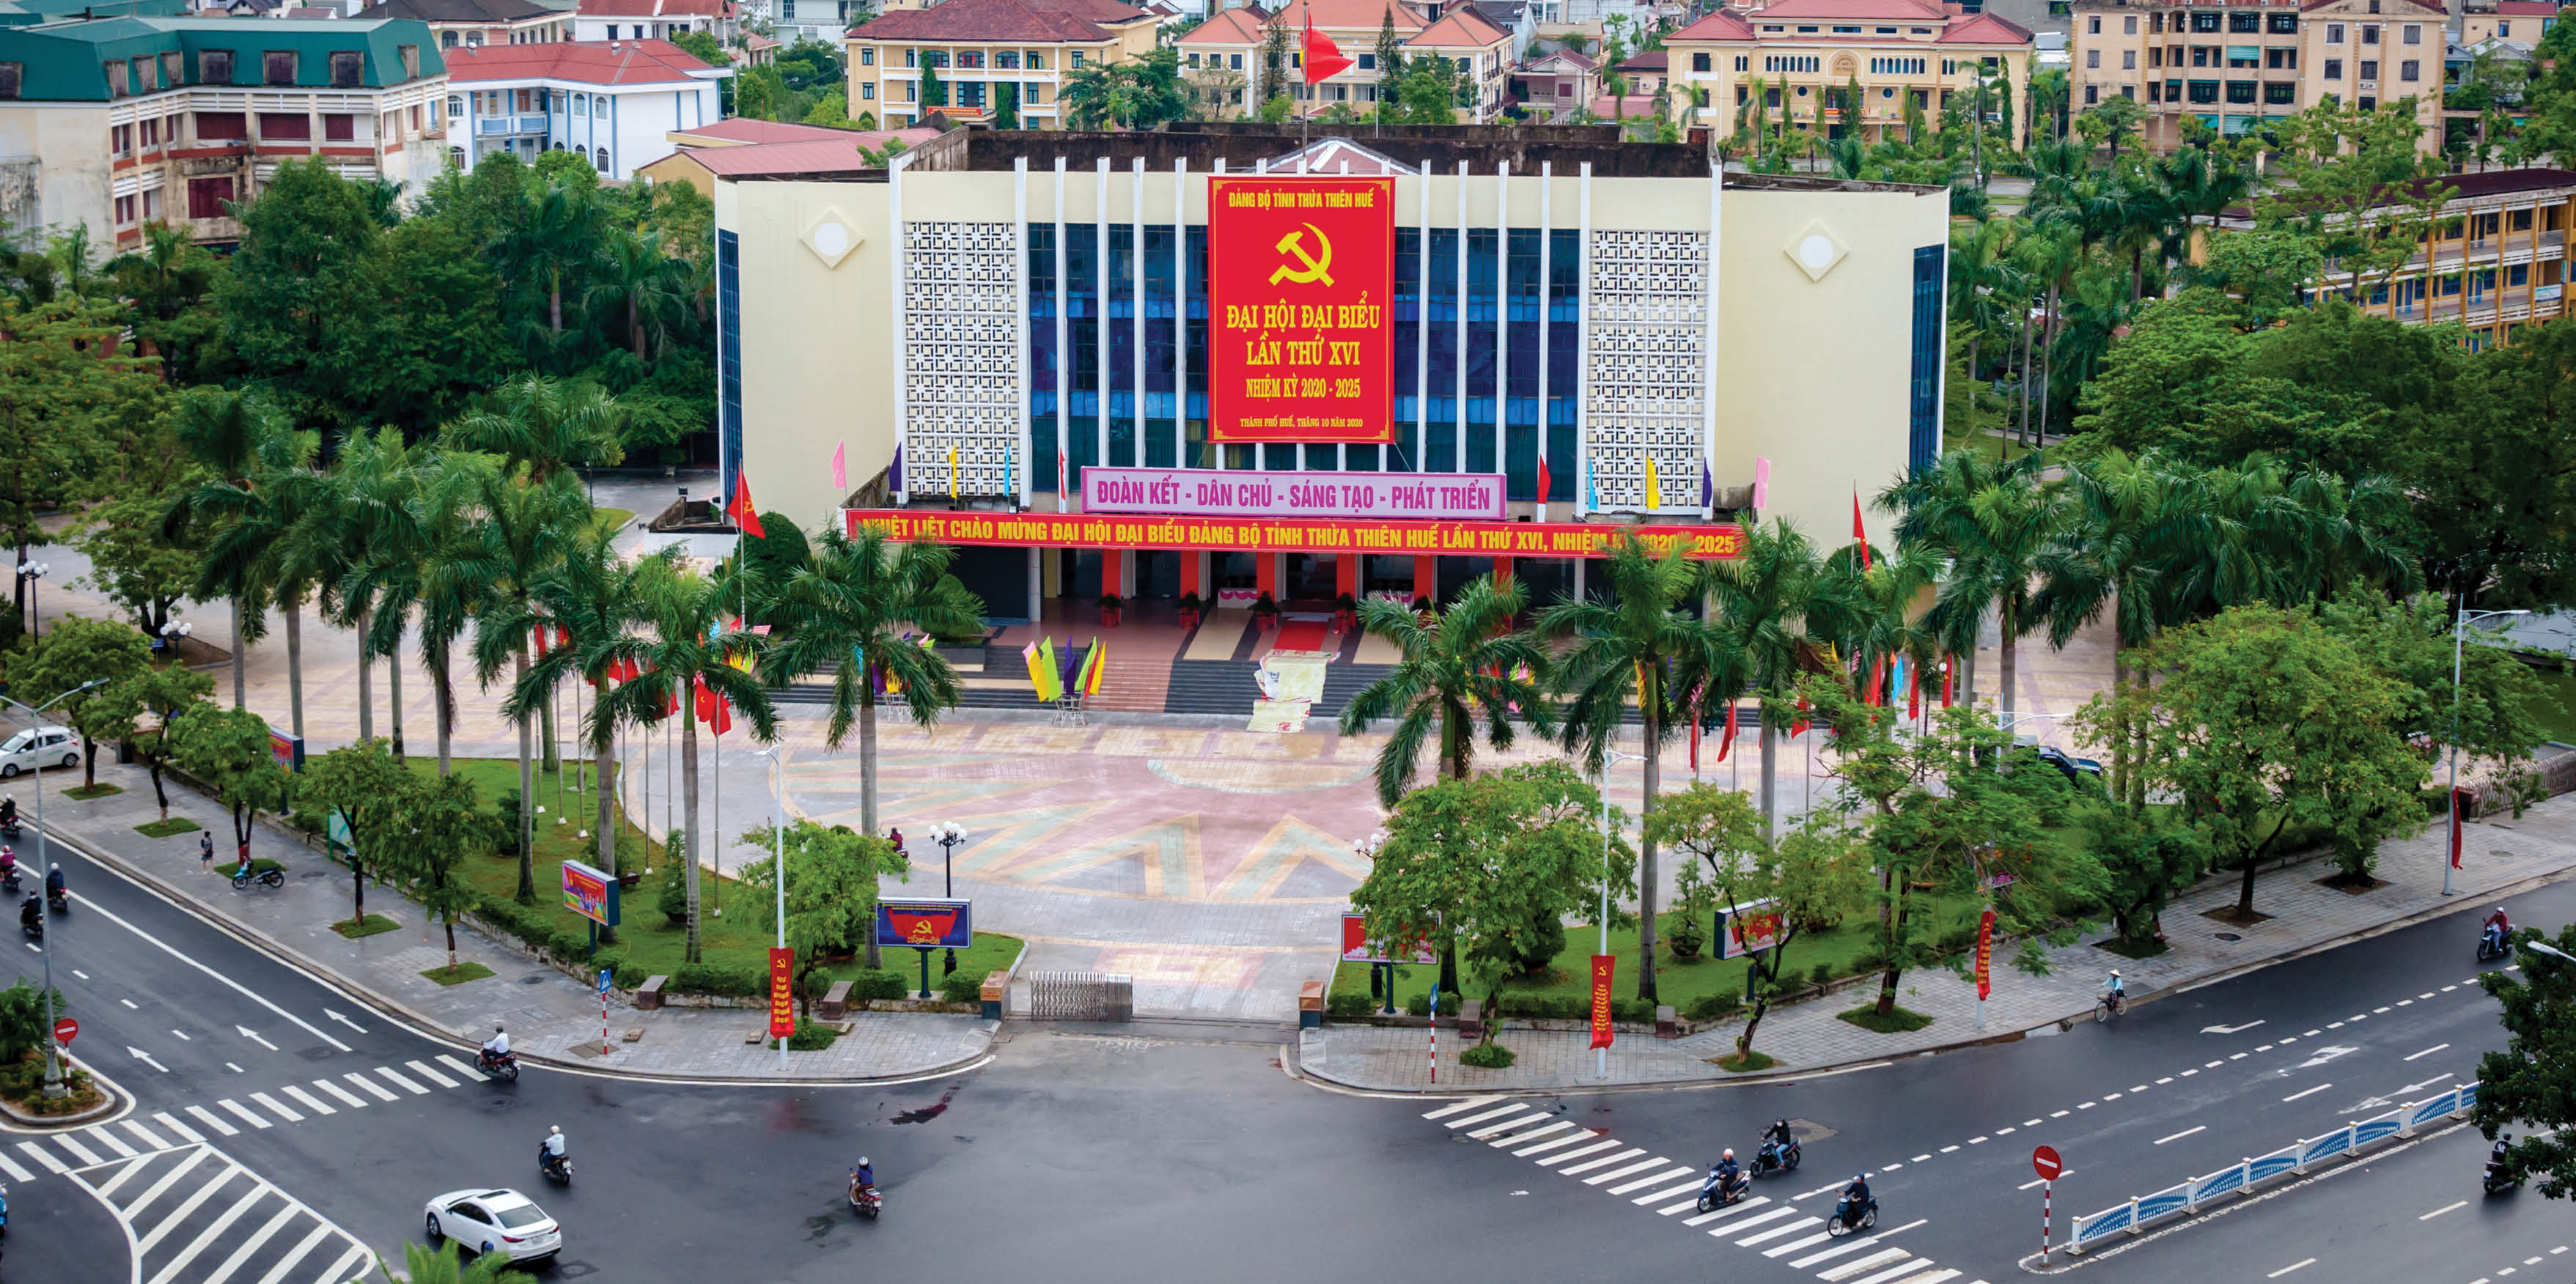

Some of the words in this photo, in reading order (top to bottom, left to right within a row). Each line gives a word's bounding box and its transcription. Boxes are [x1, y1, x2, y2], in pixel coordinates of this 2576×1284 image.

[1229, 188, 1256, 207] ĐẢNG
[1257, 189, 1271, 211] BỘ
[1273, 188, 1295, 207] TỈNH
[1298, 188, 1323, 207] THỪA
[1325, 189, 1353, 207] THIÊN
[1355, 187, 1375, 207] HUẾ
[1226, 305, 1259, 333] ĐẠI
[1263, 298, 1296, 333] HỘI
[1300, 305, 1333, 333] ĐẠI
[1338, 290, 1380, 328] BIỂU
[1246, 330, 1281, 365] LẦN
[1287, 333, 1325, 365] THỨ
[1328, 341, 1361, 365] XVI
[1245, 373, 1281, 402] NHIỆM
[1283, 372, 1298, 398] KỲ
[1301, 377, 1327, 398] 2020
[1336, 377, 1361, 398] 2025
[1240, 416, 1263, 427] THÀNH
[1264, 414, 1278, 427] PHỐ
[1279, 414, 1295, 428] HUẾ,
[1297, 416, 1320, 427] THÁNG
[1322, 418, 1330, 427] 10
[1331, 416, 1346, 427] NĂM
[1347, 418, 1364, 427] 2020
[1097, 476, 1144, 504] ĐOÀN
[1149, 474, 1180, 505] KẾT
[1197, 479, 1232, 506] DÂN
[1238, 478, 1272, 507] CHỦ
[1289, 479, 1336, 508] SÁNG
[1342, 485, 1374, 513] TẠO
[1391, 481, 1435, 509] PHÁT
[1440, 479, 1490, 510] TRIỂN
[950, 516, 993, 539] CHÀO
[998, 517, 1048, 540] MỪNG
[1051, 522, 1079, 545] ĐẠI
[1084, 519, 1111, 545] HỘI
[1116, 523, 1143, 546] ĐẠI
[1147, 517, 1185, 544] BIỂU
[1189, 520, 1234, 545] ĐẢNG
[1238, 523, 1261, 549] BỘ
[1265, 521, 1303, 546] TỈNH
[1306, 523, 1350, 547] THỪA
[1354, 525, 1402, 547] THIÊN
[1406, 523, 1440, 548] HUẾ
[1443, 523, 1475, 549] LẦN
[1479, 526, 1513, 549] THỨ
[1516, 531, 1548, 552] XVI,
[1695, 536, 1735, 554] 2025
